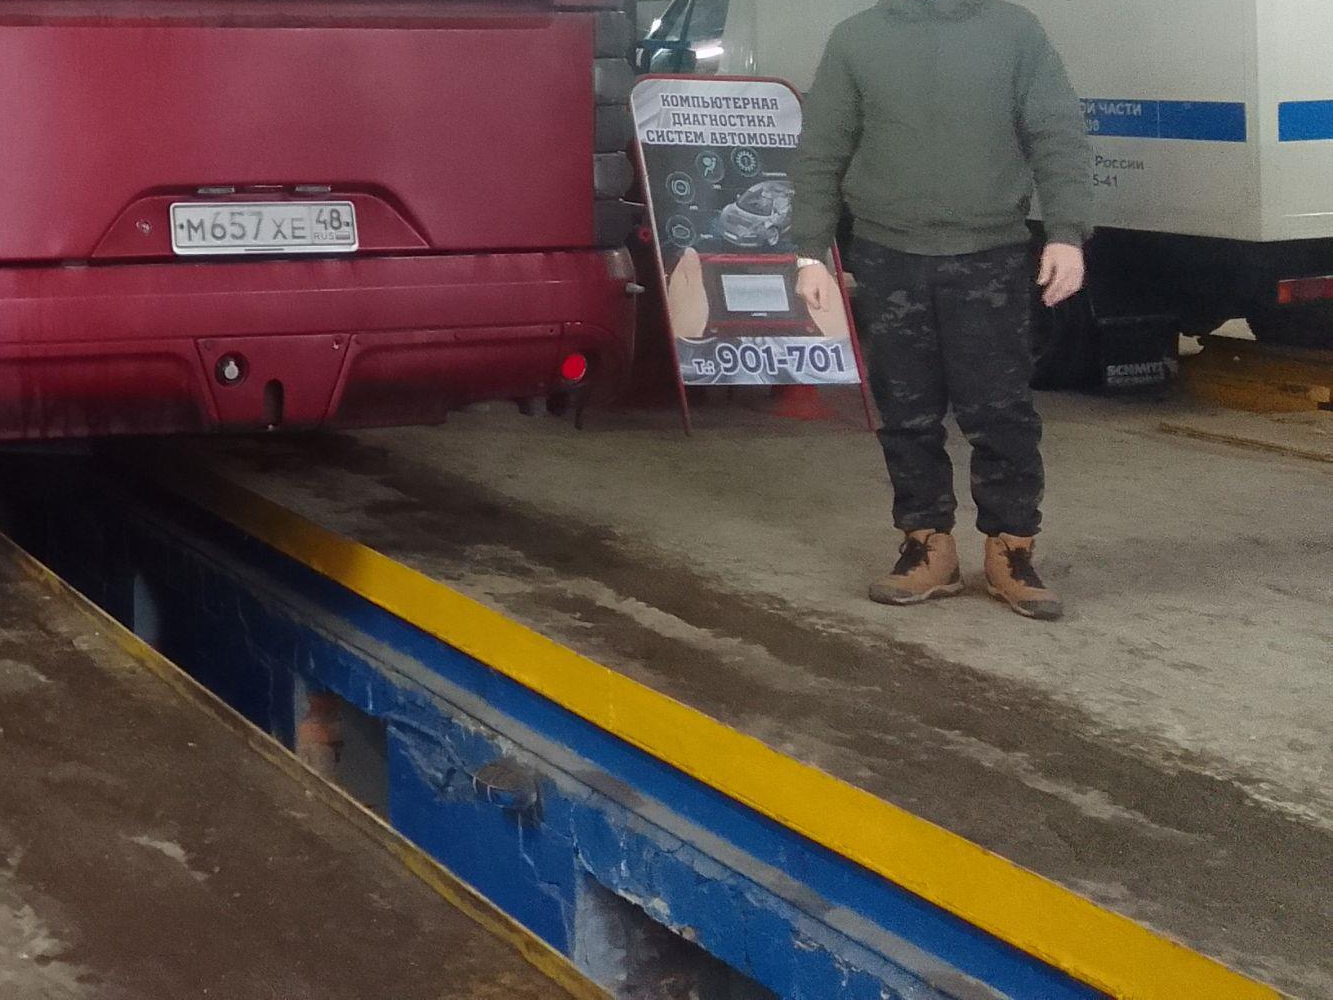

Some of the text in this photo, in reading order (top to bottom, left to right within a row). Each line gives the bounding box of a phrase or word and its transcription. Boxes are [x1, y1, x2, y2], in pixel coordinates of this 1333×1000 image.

[660, 94, 779, 110] КОМПЬЮТЕРНАЯ
[1098, 102, 1143, 117] ЧАСТИ
[671, 112, 776, 128] ДИАГНОСТИКА
[646, 129, 706, 144] СИСТЕМ
[1094, 154, 1145, 170] России
[315, 208, 344, 231] 48
[314, 232, 335, 240] RUS
[716, 343, 846, 375] 901-701
